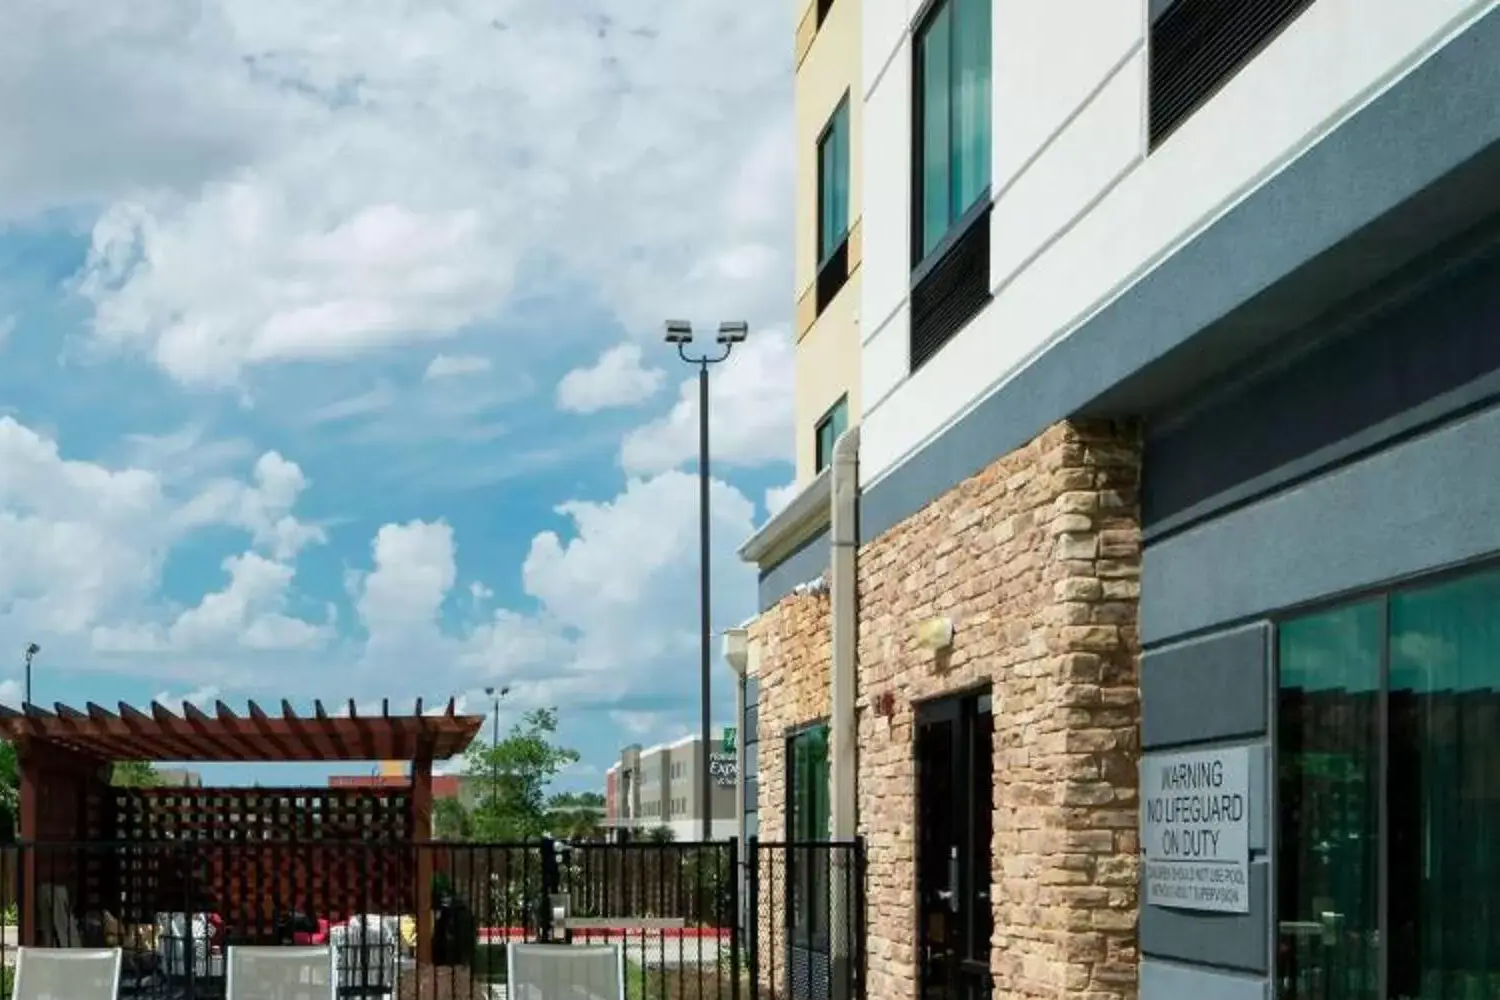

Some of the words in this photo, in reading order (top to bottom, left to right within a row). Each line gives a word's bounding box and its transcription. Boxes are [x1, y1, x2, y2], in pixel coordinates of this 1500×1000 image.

[1161, 759, 1224, 791] WARNING
[1147, 799, 1163, 824] NO
[1165, 793, 1244, 824] LIFEGUARD
[1162, 830, 1179, 855] ON
[1183, 829, 1221, 857] DUTY
